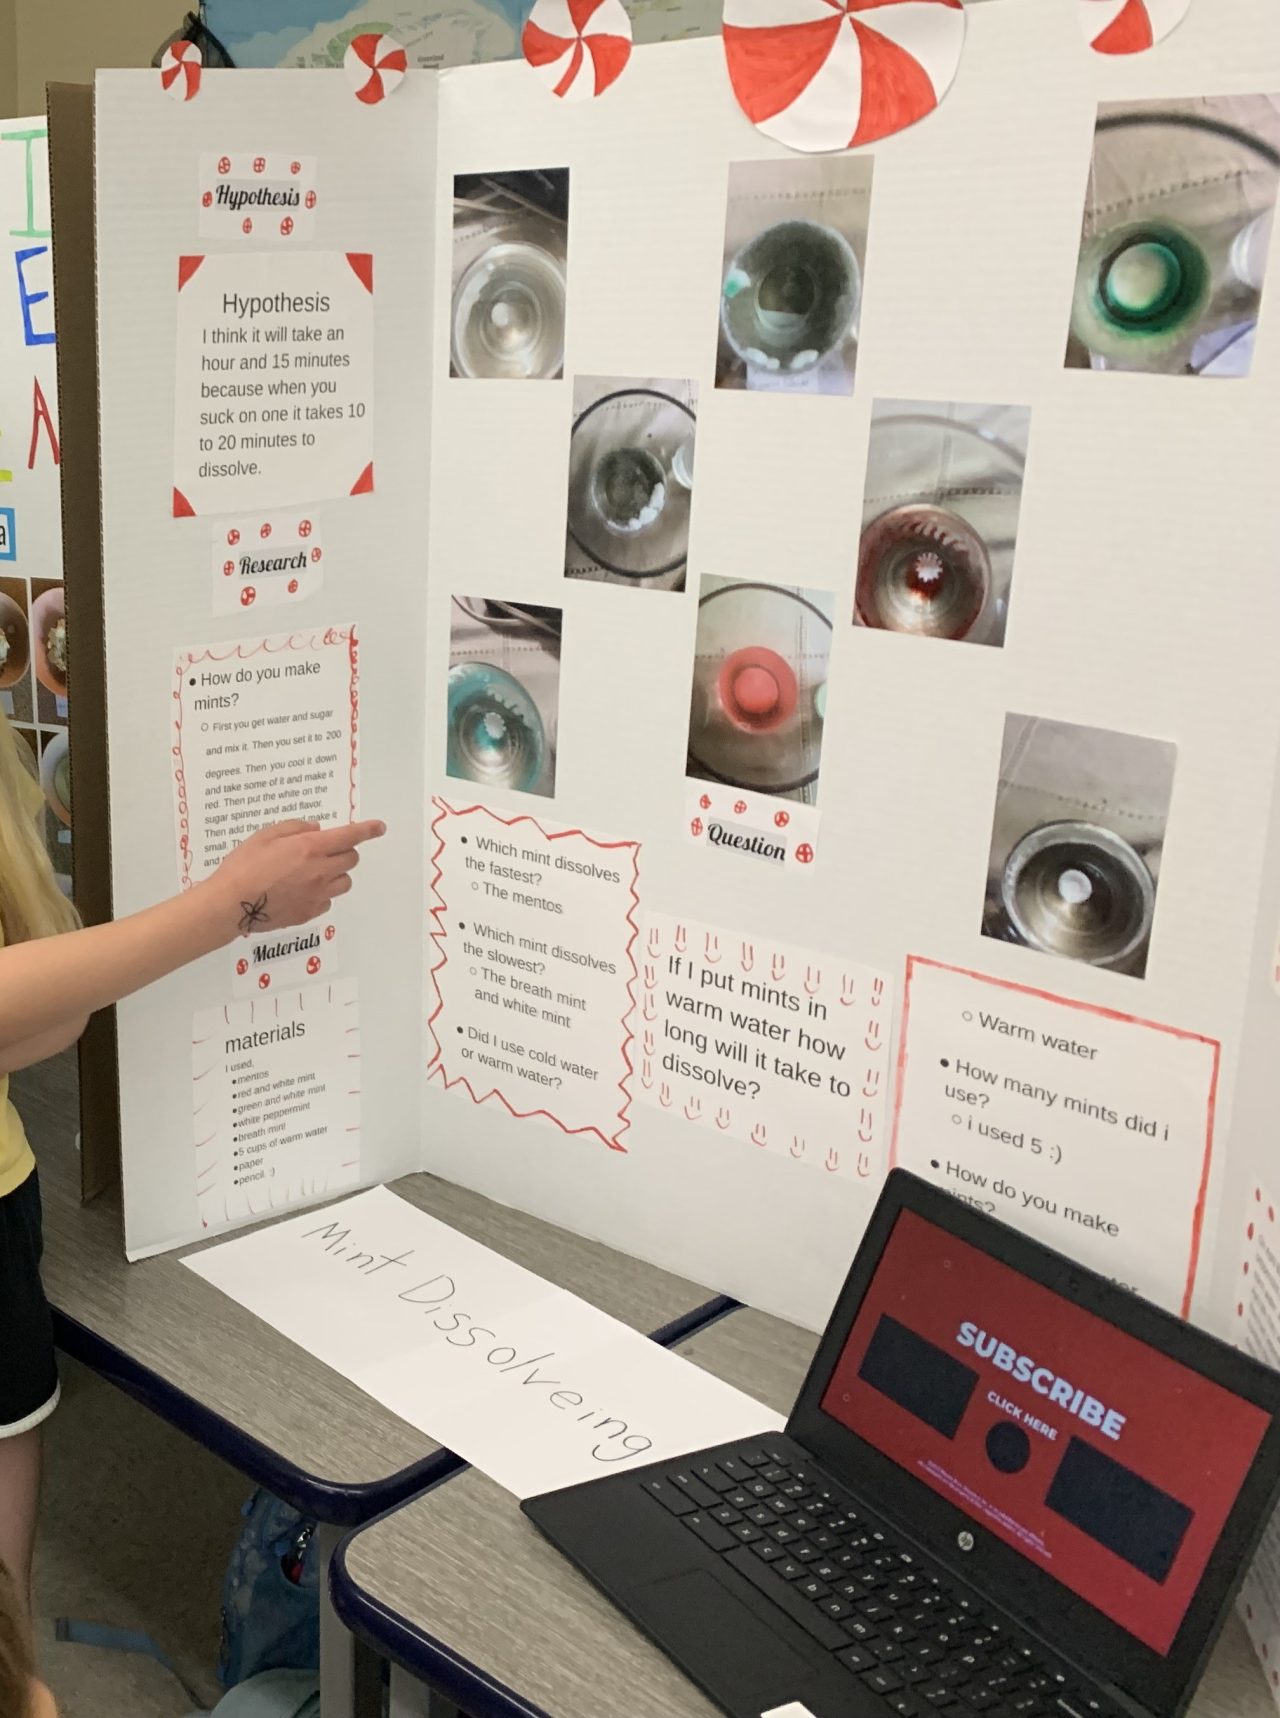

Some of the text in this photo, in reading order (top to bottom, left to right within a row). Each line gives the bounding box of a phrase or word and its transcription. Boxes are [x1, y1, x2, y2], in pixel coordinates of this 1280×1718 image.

[216, 184, 300, 210] Hypothesis
[224, 292, 330, 318] Hypothesis
[203, 326, 344, 344] I think it will take an
[202, 352, 350, 371] hour and 15 minutes
[201, 380, 336, 398] because when you
[200, 403, 365, 425] suck on one it takes 10
[200, 433, 315, 451] to 20 minutes to
[199, 460, 261, 478] dissolve.
[239, 552, 306, 575] Research
[202, 661, 320, 686] How do you make
[195, 693, 239, 710] mints?
[213, 710, 333, 731] First you get water and sugar
[708, 824, 785, 861] Question
[466, 856, 542, 885] the fastest?
[476, 836, 620, 883] Which mint dissolves
[483, 881, 563, 914] The mentos
[253, 932, 320, 963] Materials
[464, 942, 545, 975] the slowest?
[474, 922, 616, 974] Which mint dissolves
[481, 967, 586, 1011] The breath mint
[669, 956, 826, 1020] If I put mints in
[475, 989, 570, 1028] and white mint
[225, 1021, 305, 1054] materials
[666, 991, 846, 1060] warm water how
[979, 1012, 1098, 1060] Warm water
[462, 1048, 562, 1088] or warm water?
[468, 1027, 598, 1080] Did I use cold water
[665, 1019, 850, 1096] long will it take to
[238, 1071, 269, 1084] mentos
[238, 1073, 316, 1098] red and white mint
[663, 1054, 760, 1099] dissolve?
[238, 1084, 325, 1114] green and white mint
[946, 1085, 990, 1108] use?
[956, 1059, 1169, 1141] How many mints did i
[238, 1102, 310, 1127] white peppermint
[238, 1122, 286, 1142] breath mint
[238, 1126, 327, 1156] 5 cups of warm water
[967, 1115, 973, 1130] i
[978, 1123, 1024, 1148] used
[1031, 1137, 1042, 1154] 5
[239, 1158, 263, 1172] paper
[946, 1161, 1119, 1236] How do you make
[301, 1221, 653, 1462] Mint Dissolveing
[956, 1321, 1127, 1441] SUBSCRIBE
[987, 1390, 1058, 1441] CLICK HERE
